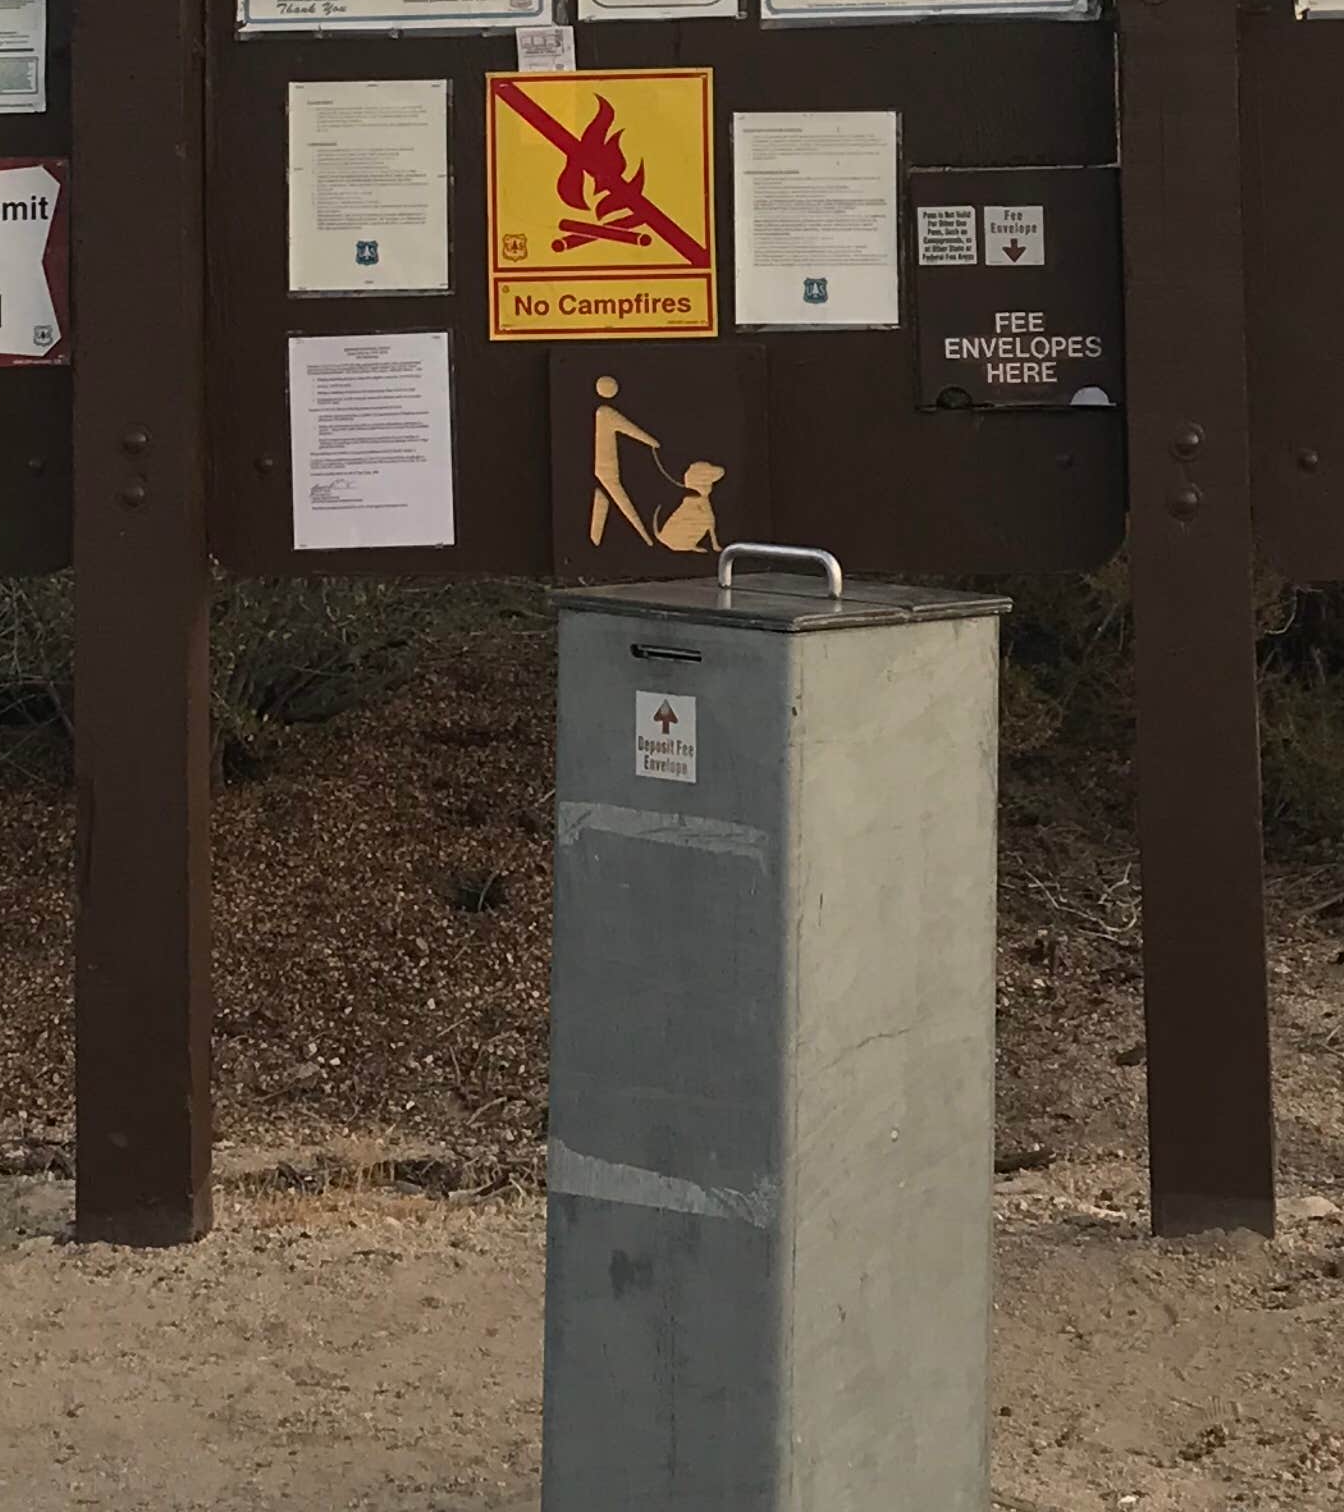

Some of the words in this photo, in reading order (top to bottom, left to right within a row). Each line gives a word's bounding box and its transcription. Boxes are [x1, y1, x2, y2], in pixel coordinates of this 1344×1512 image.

[1003, 209, 1025, 222] Fee
[990, 221, 1039, 236] Envelope
[513, 294, 551, 317] No
[557, 293, 693, 320] Campfires
[994, 311, 1046, 334] FEE
[944, 336, 1103, 360] ENVELOPES
[986, 361, 1059, 384] HERE
[637, 735, 675, 756] Deposit
[676, 739, 695, 759] Fee
